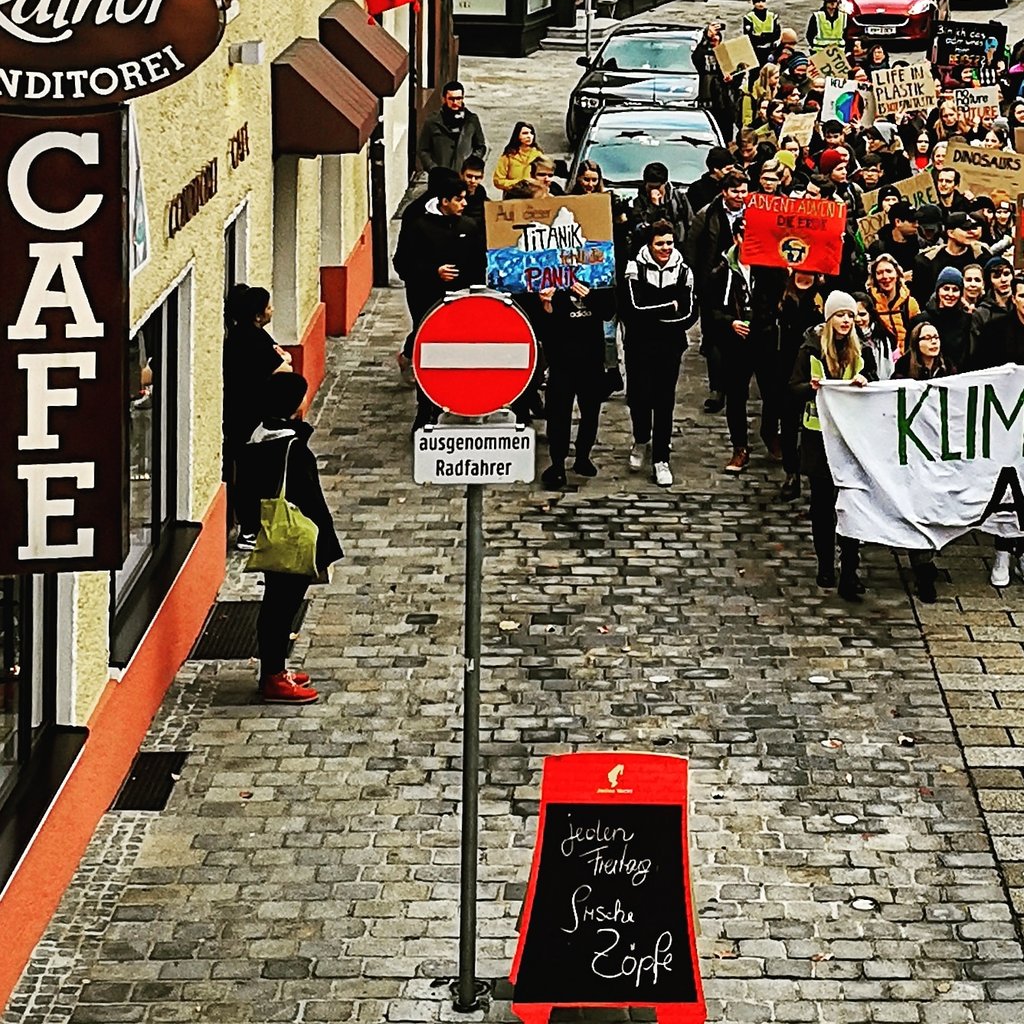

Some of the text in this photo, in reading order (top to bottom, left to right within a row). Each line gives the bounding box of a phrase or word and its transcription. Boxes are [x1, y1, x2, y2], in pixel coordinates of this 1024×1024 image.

[875, 64, 924, 85] LIFE IN
[875, 82, 925, 102] PLASTIK
[952, 149, 1022, 172] DINOSAURS
[7, 131, 104, 561] CAFE
[419, 436, 530, 454] ausgenommen
[436, 459, 512, 477] Radfahrer
[561, 813, 634, 856] jeden
[579, 844, 652, 886] Freitag
[591, 928, 673, 988] Zöpfe
